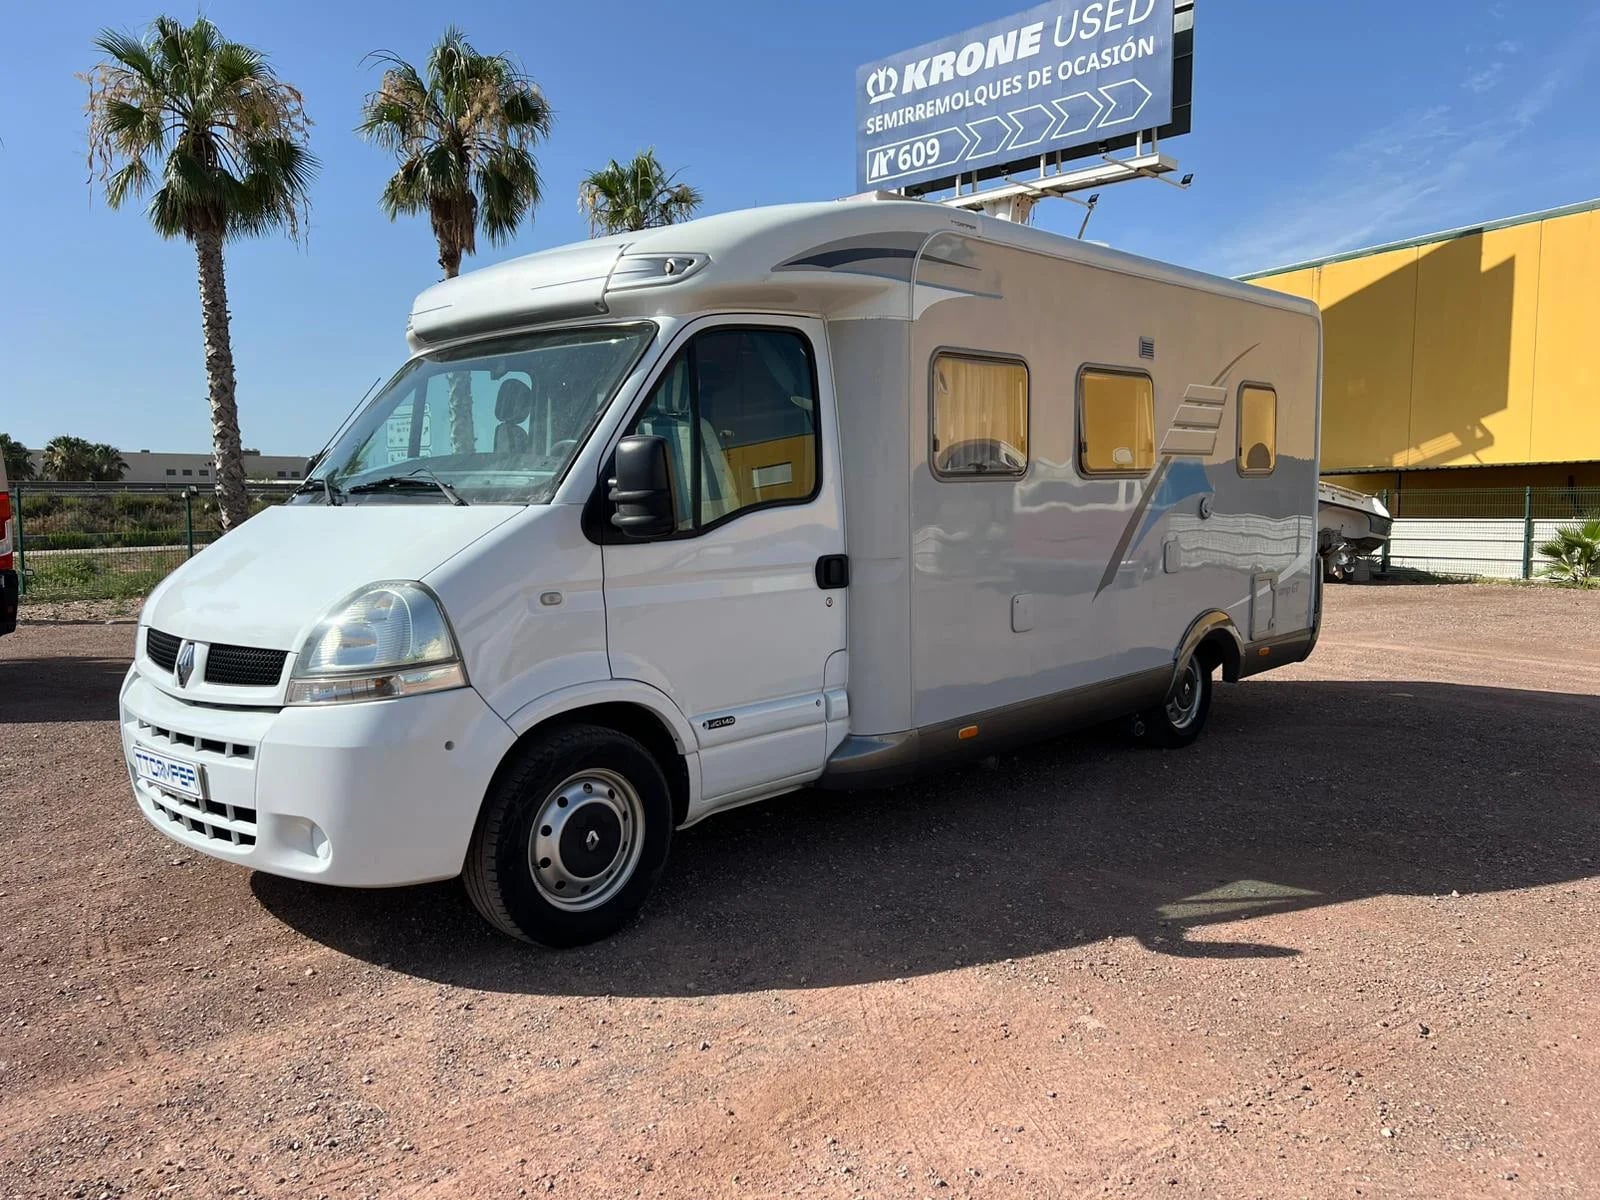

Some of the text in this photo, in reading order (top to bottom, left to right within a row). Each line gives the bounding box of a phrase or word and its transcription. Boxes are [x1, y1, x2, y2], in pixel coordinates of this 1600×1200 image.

[866, 35, 1155, 135] SEMIRREMOLQUES DE OCASIÓN
[901, 0, 1156, 95] KRONE USED
[897, 137, 940, 171] 609
